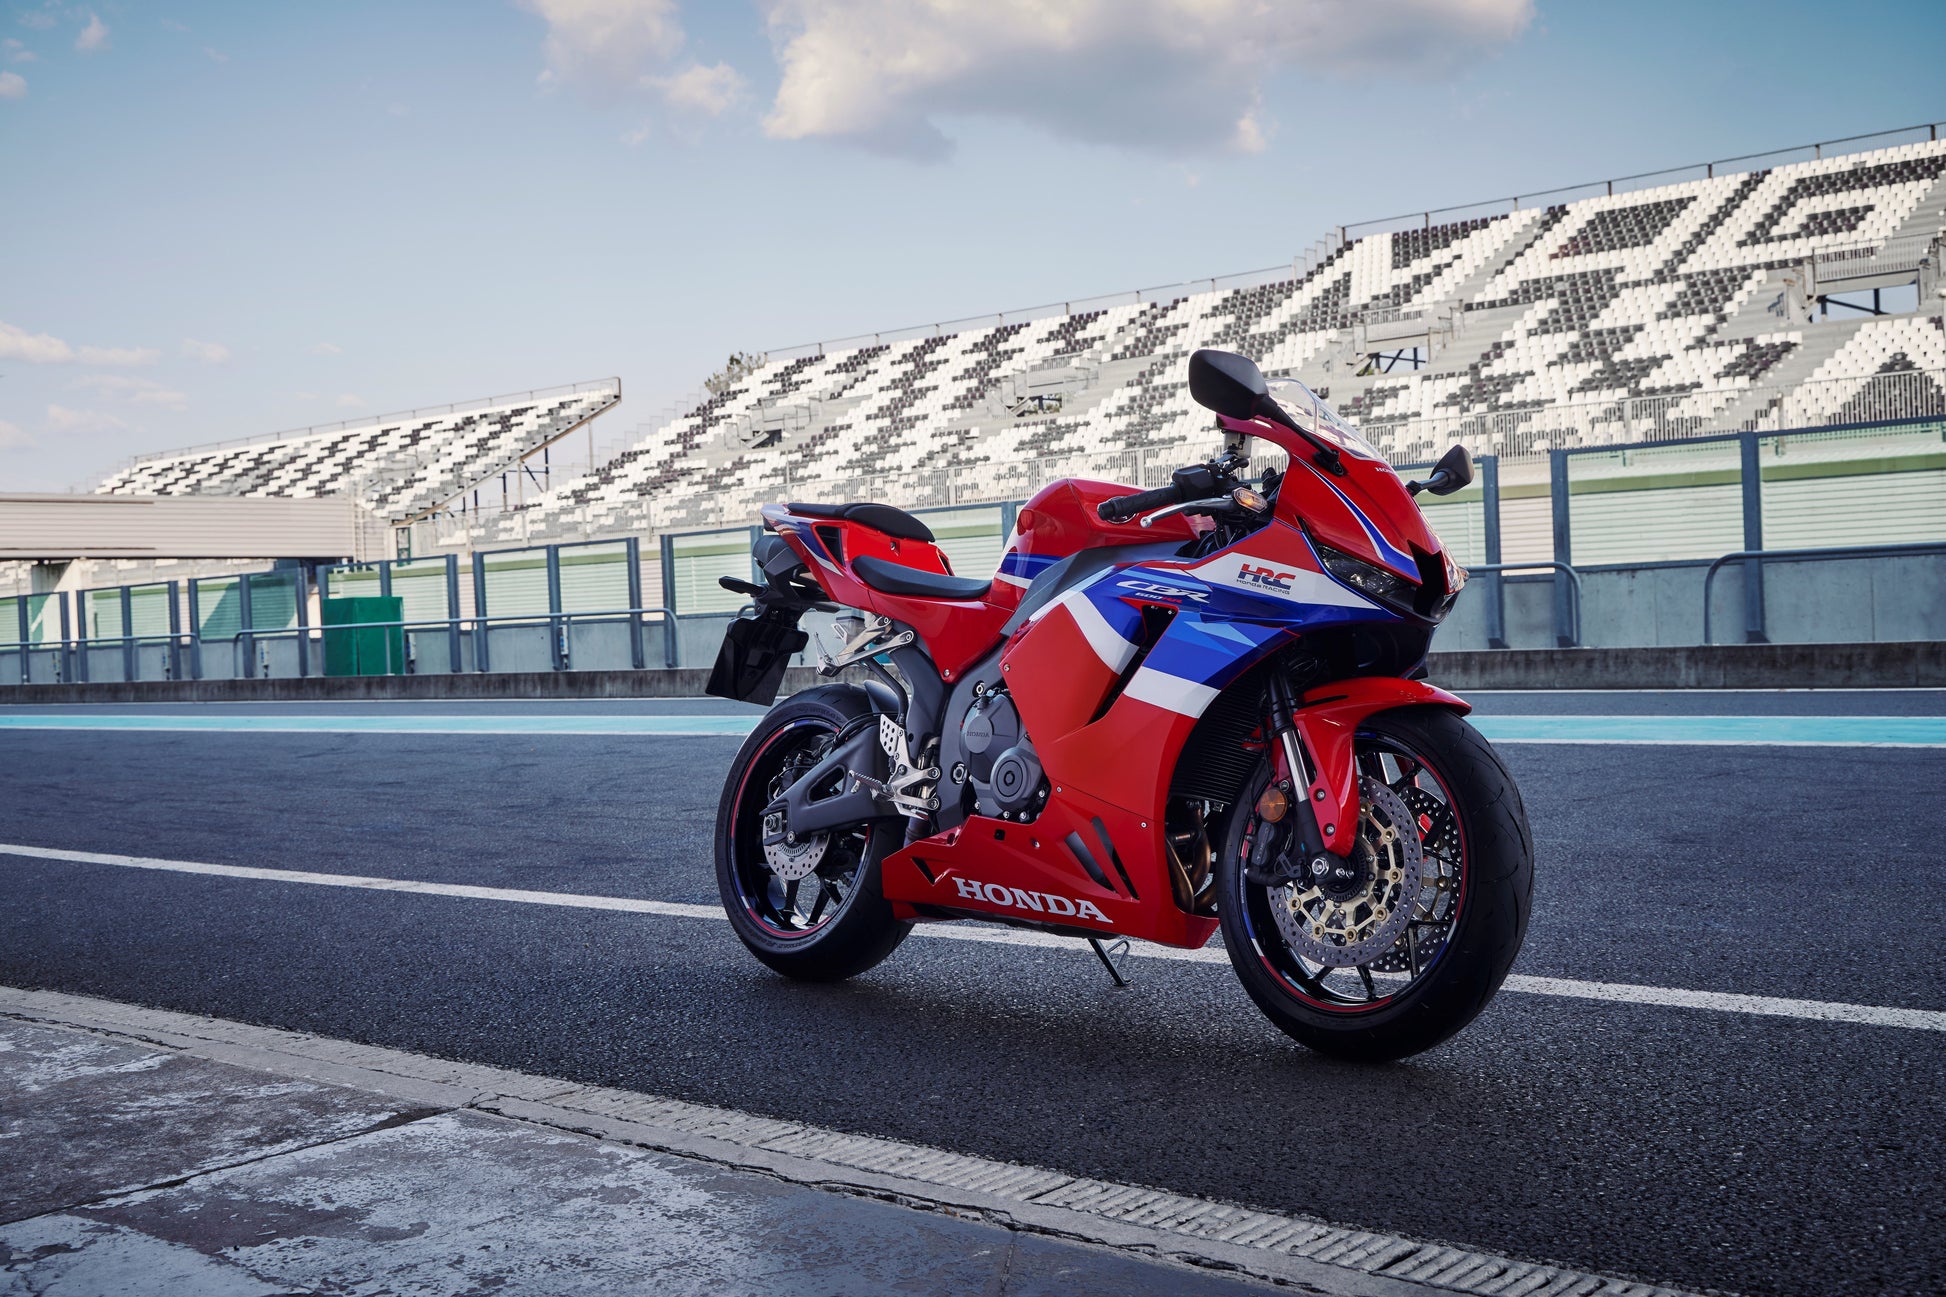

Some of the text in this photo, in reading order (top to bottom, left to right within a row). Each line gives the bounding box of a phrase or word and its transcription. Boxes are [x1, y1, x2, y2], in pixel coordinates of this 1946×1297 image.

[1238, 563, 1296, 590] HRC
[1116, 580, 1210, 603] CBR
[1263, 585, 1290, 595] RACING
[952, 877, 1113, 923] HONDA
